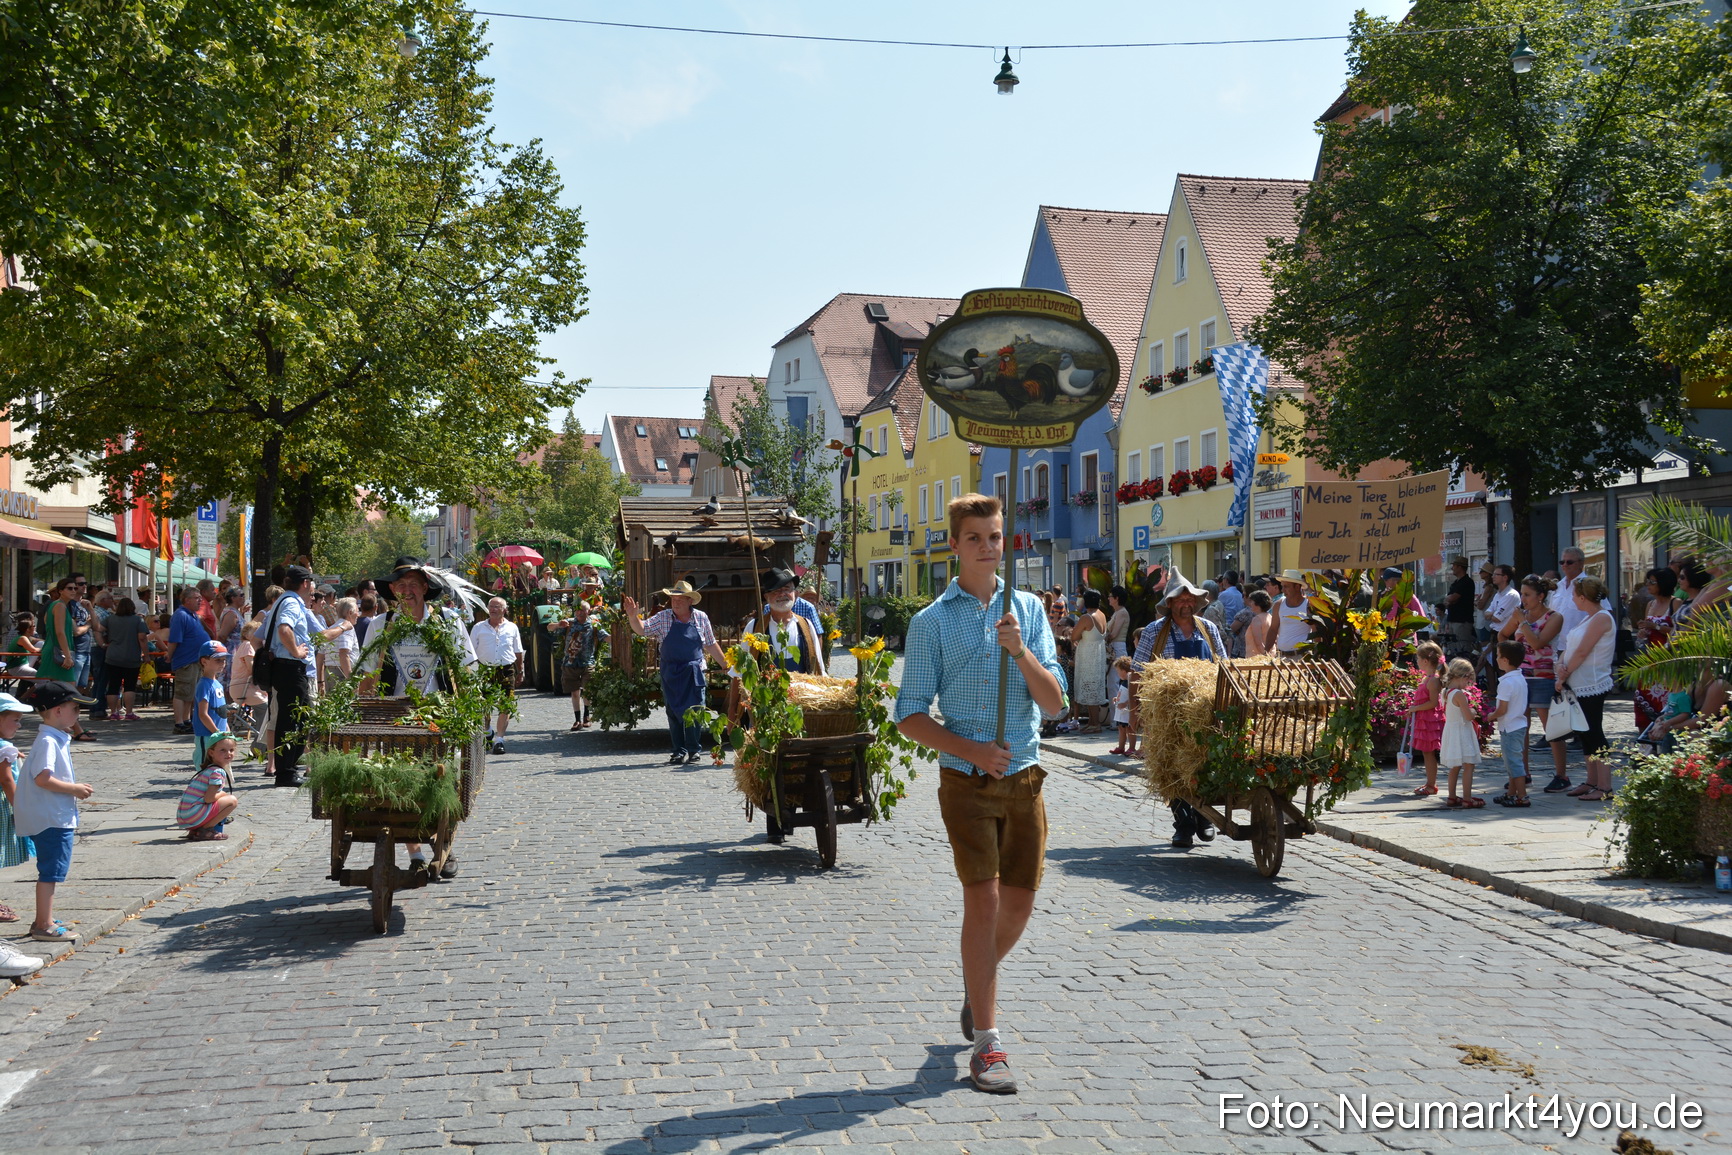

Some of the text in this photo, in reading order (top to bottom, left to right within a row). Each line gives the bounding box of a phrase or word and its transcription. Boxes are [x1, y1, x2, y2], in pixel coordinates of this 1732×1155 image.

[872, 474, 888, 489] HOTEL
[1306, 482, 1436, 504] Meine Tiere bleiben
[1360, 503, 1406, 520] im Stall
[1304, 529, 1322, 539] nur
[1366, 520, 1390, 538] stell
[1397, 516, 1421, 534] mich
[1311, 538, 1415, 565] dieser Hitzequal
